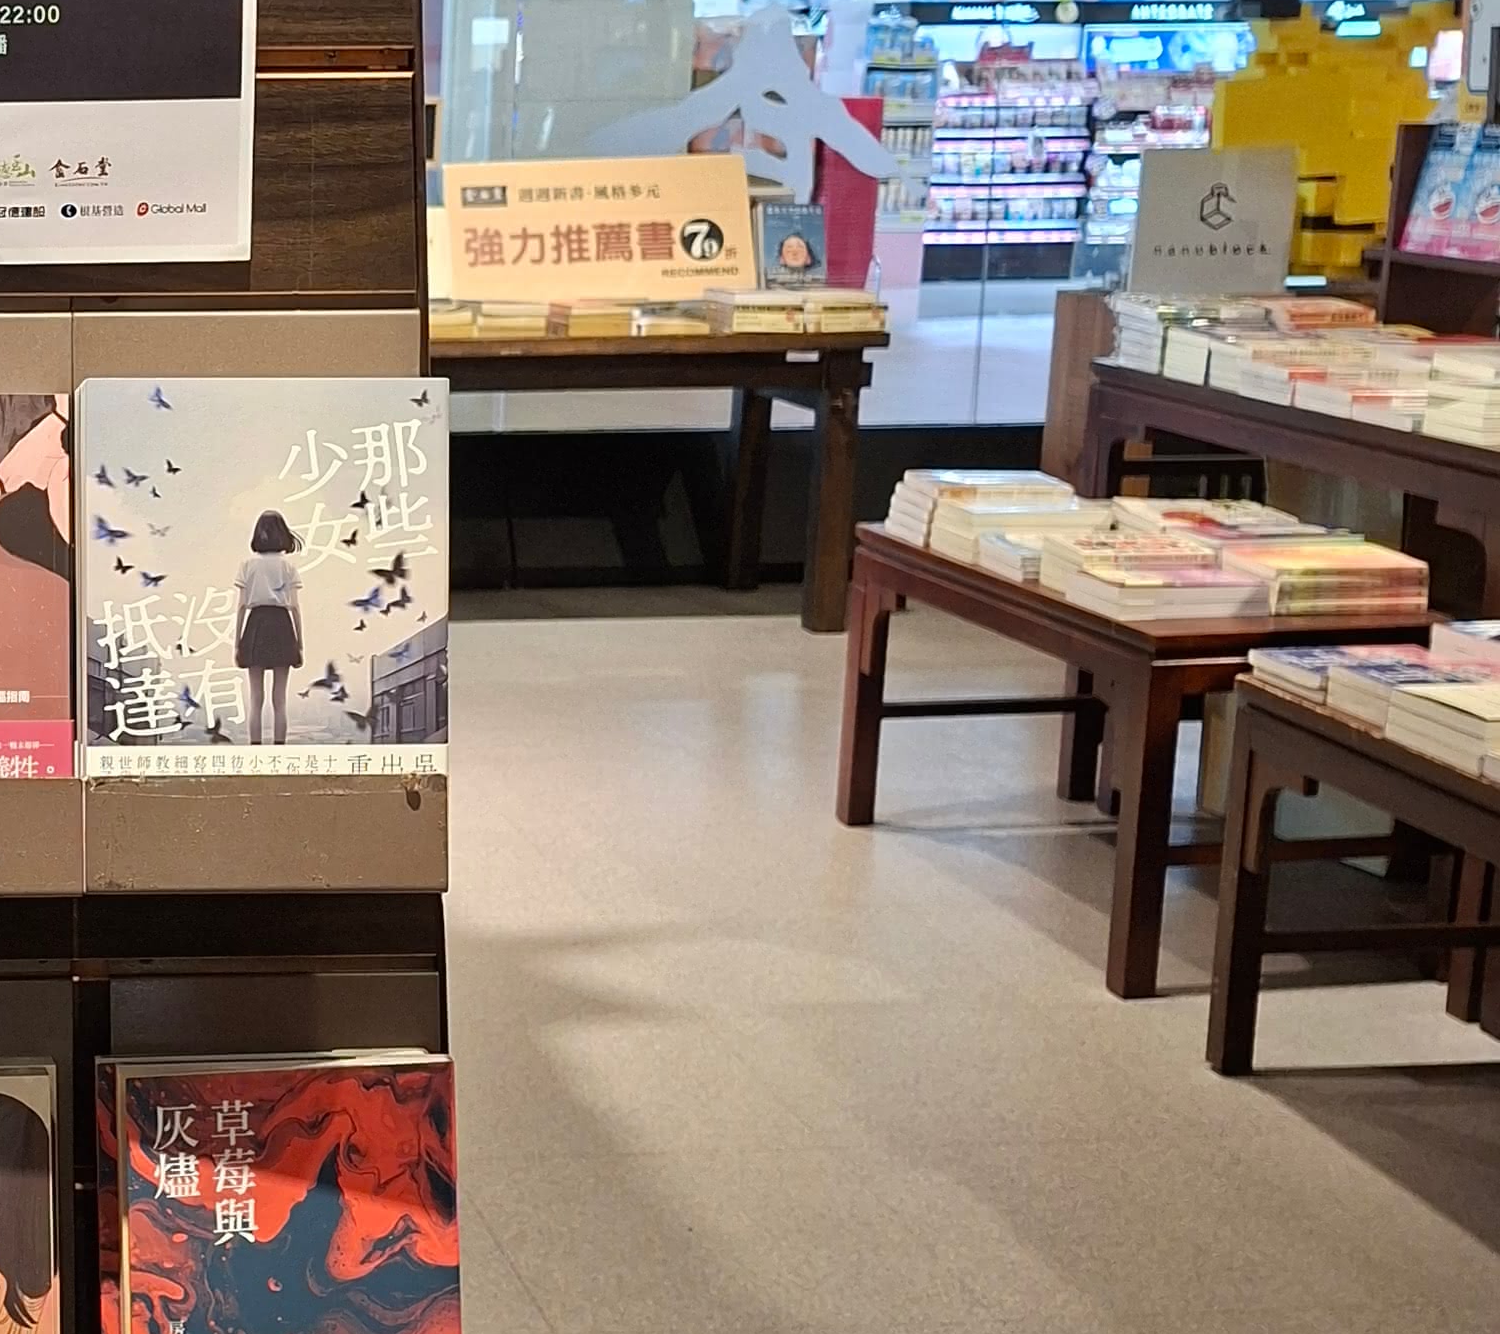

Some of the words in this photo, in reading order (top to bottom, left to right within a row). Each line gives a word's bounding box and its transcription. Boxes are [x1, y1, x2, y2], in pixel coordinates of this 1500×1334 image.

[0, 5, 61, 25] 22:00
[49, 157, 112, 179] 金石堂
[150, 202, 186, 215] Global
[188, 202, 207, 214] Mall
[464, 221, 676, 268] 強力推薦書
[1153, 242, 1271, 257] nanoblock
[661, 267, 739, 278] RECOMMEND
[278, 430, 361, 574] 少女
[352, 419, 438, 567] 那些
[94, 595, 185, 742] 抵達
[152, 1103, 202, 1201] 灰燼
[210, 1099, 259, 1245] 草莓與
